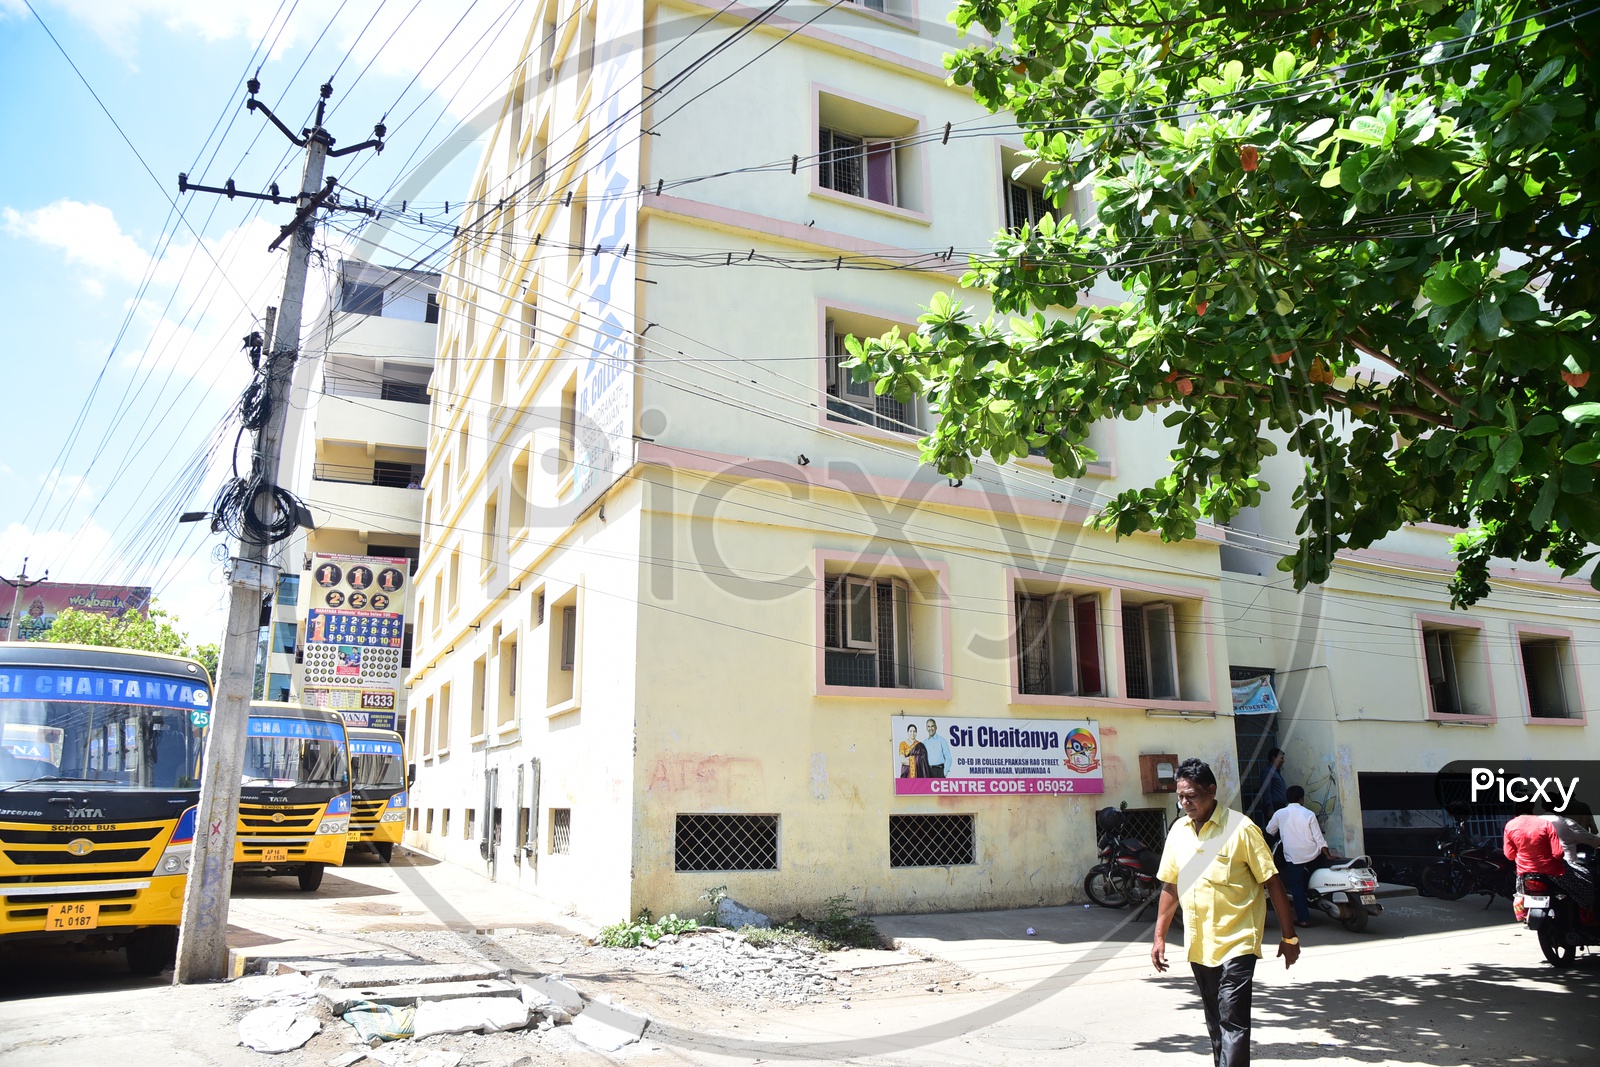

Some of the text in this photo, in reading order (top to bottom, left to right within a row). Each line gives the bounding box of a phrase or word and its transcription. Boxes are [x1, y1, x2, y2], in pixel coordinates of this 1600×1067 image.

[321, 566, 394, 588] 1 1 1
[68, 593, 125, 608] WONDERLA
[329, 592, 385, 607] 2 2 2
[0, 674, 194, 703] RI CHAITANYA
[363, 695, 393, 707] 14333
[193, 712, 208, 724] 25
[342, 713, 367, 722] YANA
[949, 725, 1059, 750] Sri Chaitanya
[350, 744, 393, 753] AITANYA
[957, 758, 974, 766] CO-ED
[974, 758, 981, 766] JR
[931, 781, 986, 792] CENTRE
[990, 781, 1026, 792] CODE
[1037, 781, 1074, 792] 05052
[0, 808, 43, 816] arcopolo
[67, 808, 104, 818] TATA
[60, 905, 84, 914] AP 16
[54, 917, 91, 928] TL 0187
